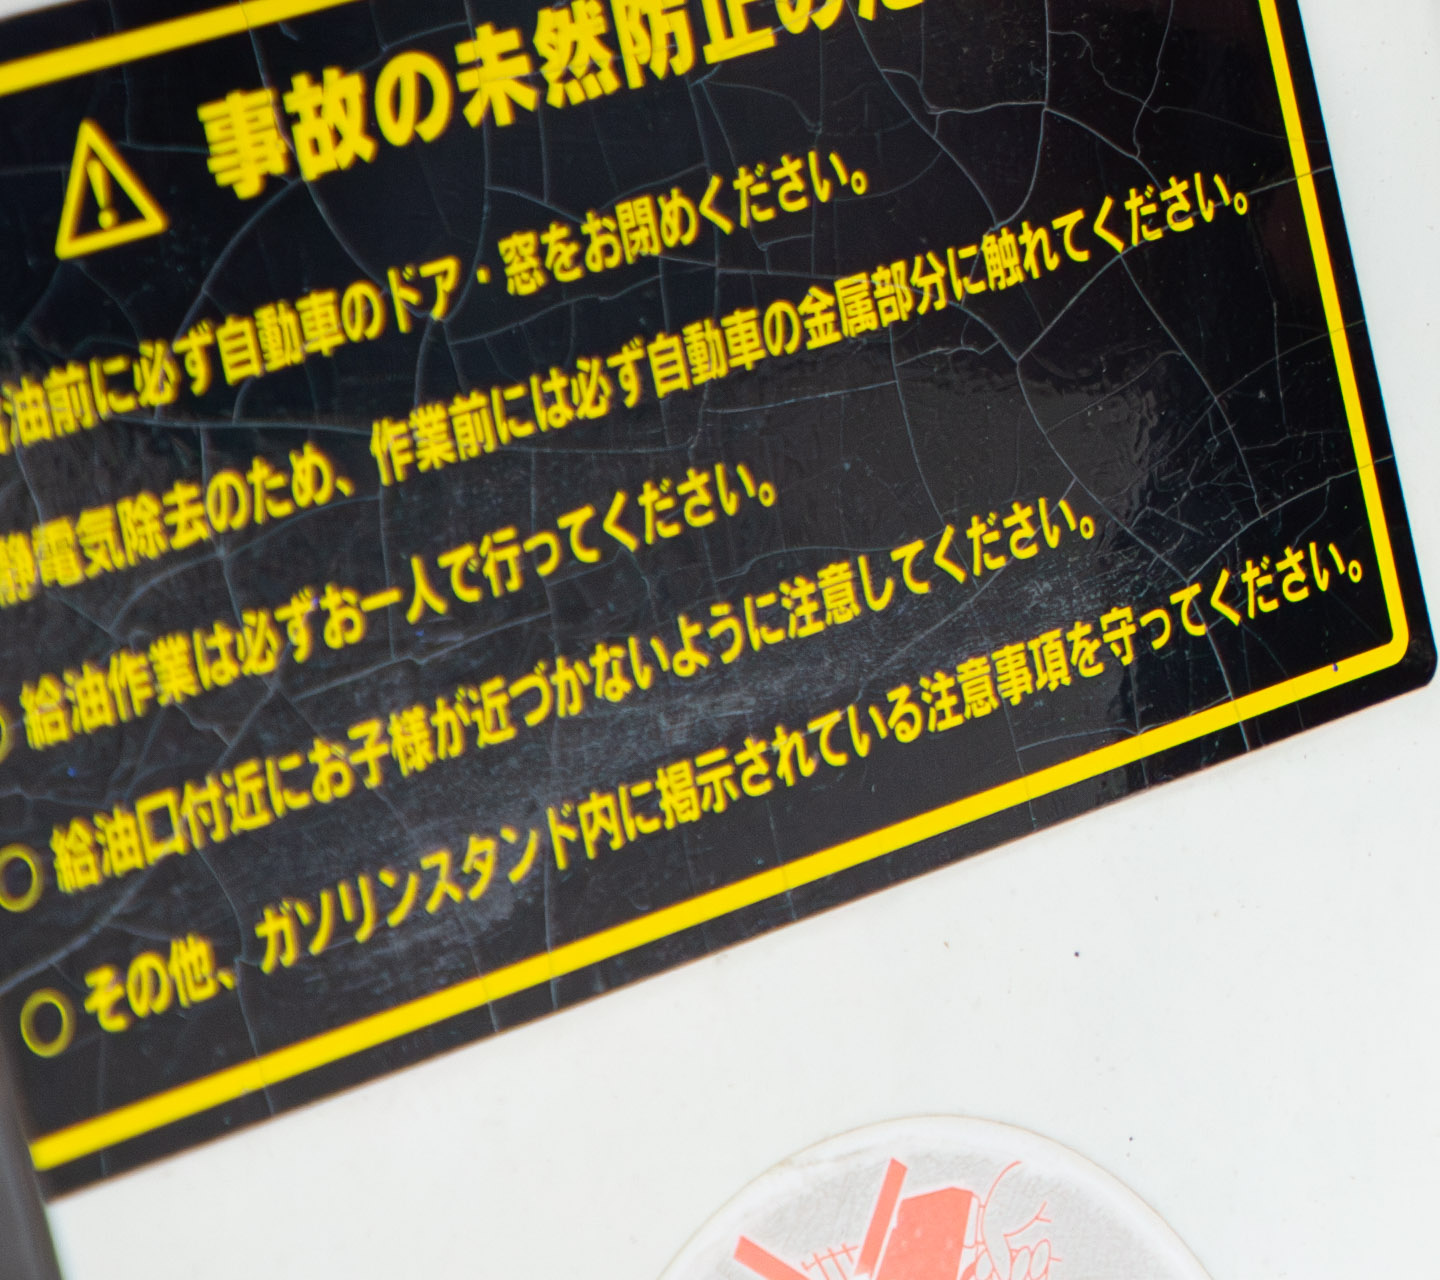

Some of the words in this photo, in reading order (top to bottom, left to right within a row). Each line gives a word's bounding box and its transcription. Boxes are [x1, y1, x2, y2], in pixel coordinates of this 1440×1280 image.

[0, 151, 868, 455] 油前に必ず自動車のドア・窓をお閉めください。
[20, 464, 777, 749] 給油作業は必ずお一人で行ってください。
[50, 497, 1096, 892] 給油口付近にお子様が近づかないように注意してください。
